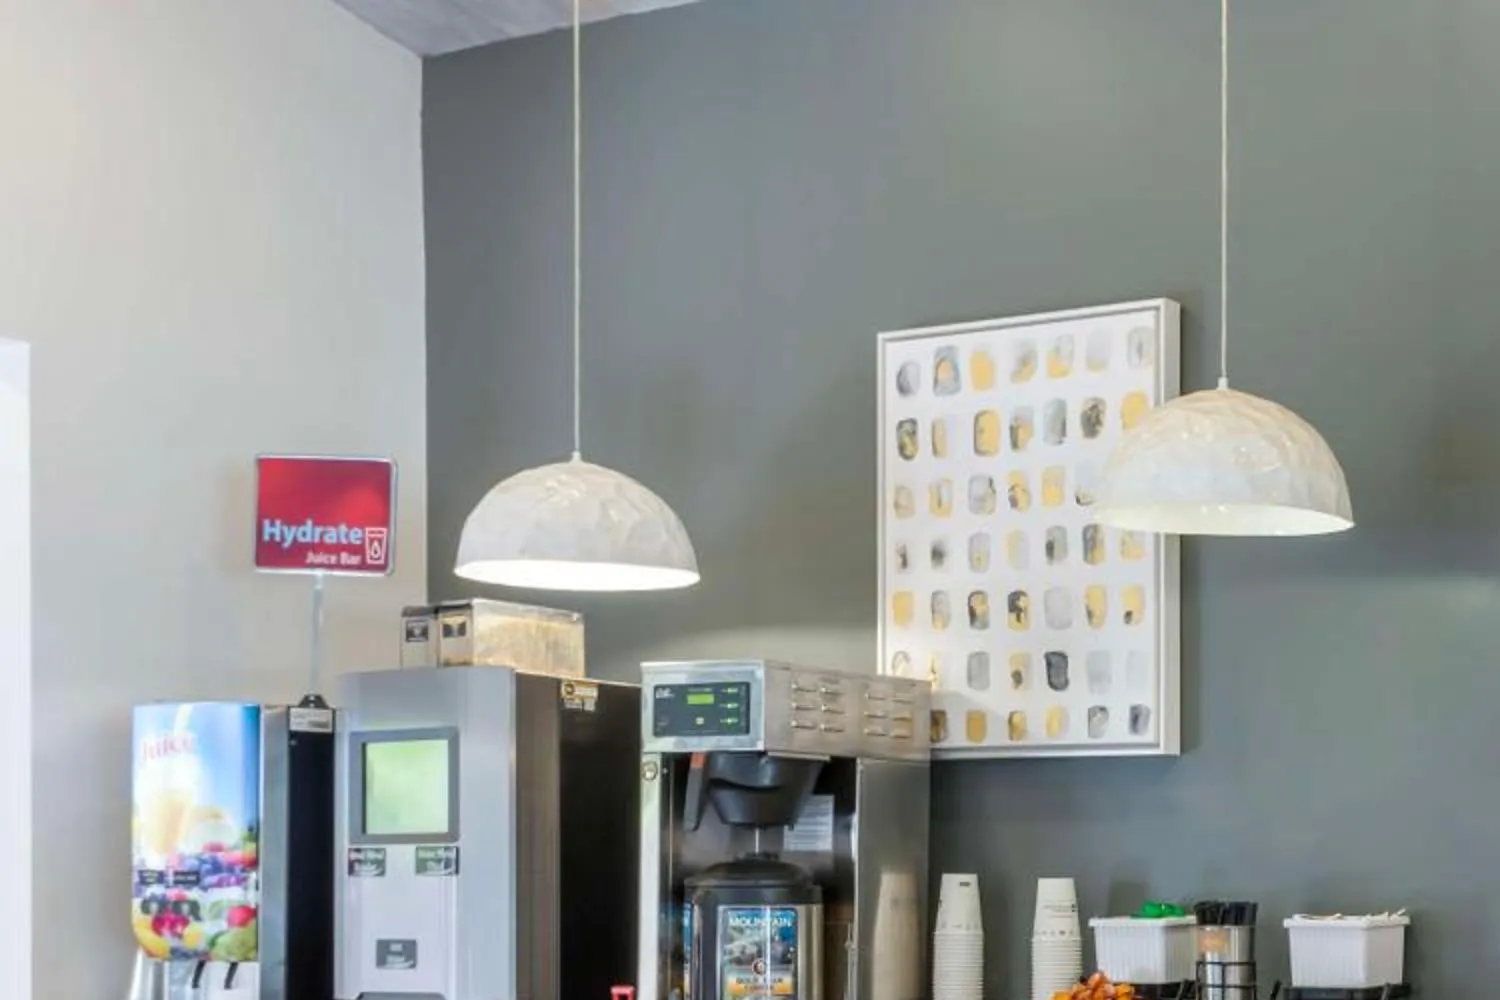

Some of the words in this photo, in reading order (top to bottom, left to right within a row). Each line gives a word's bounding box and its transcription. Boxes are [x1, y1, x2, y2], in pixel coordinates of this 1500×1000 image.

[262, 518, 363, 549] Hydrate
[305, 550, 337, 565] Juice
[339, 551, 362, 565] Bar
